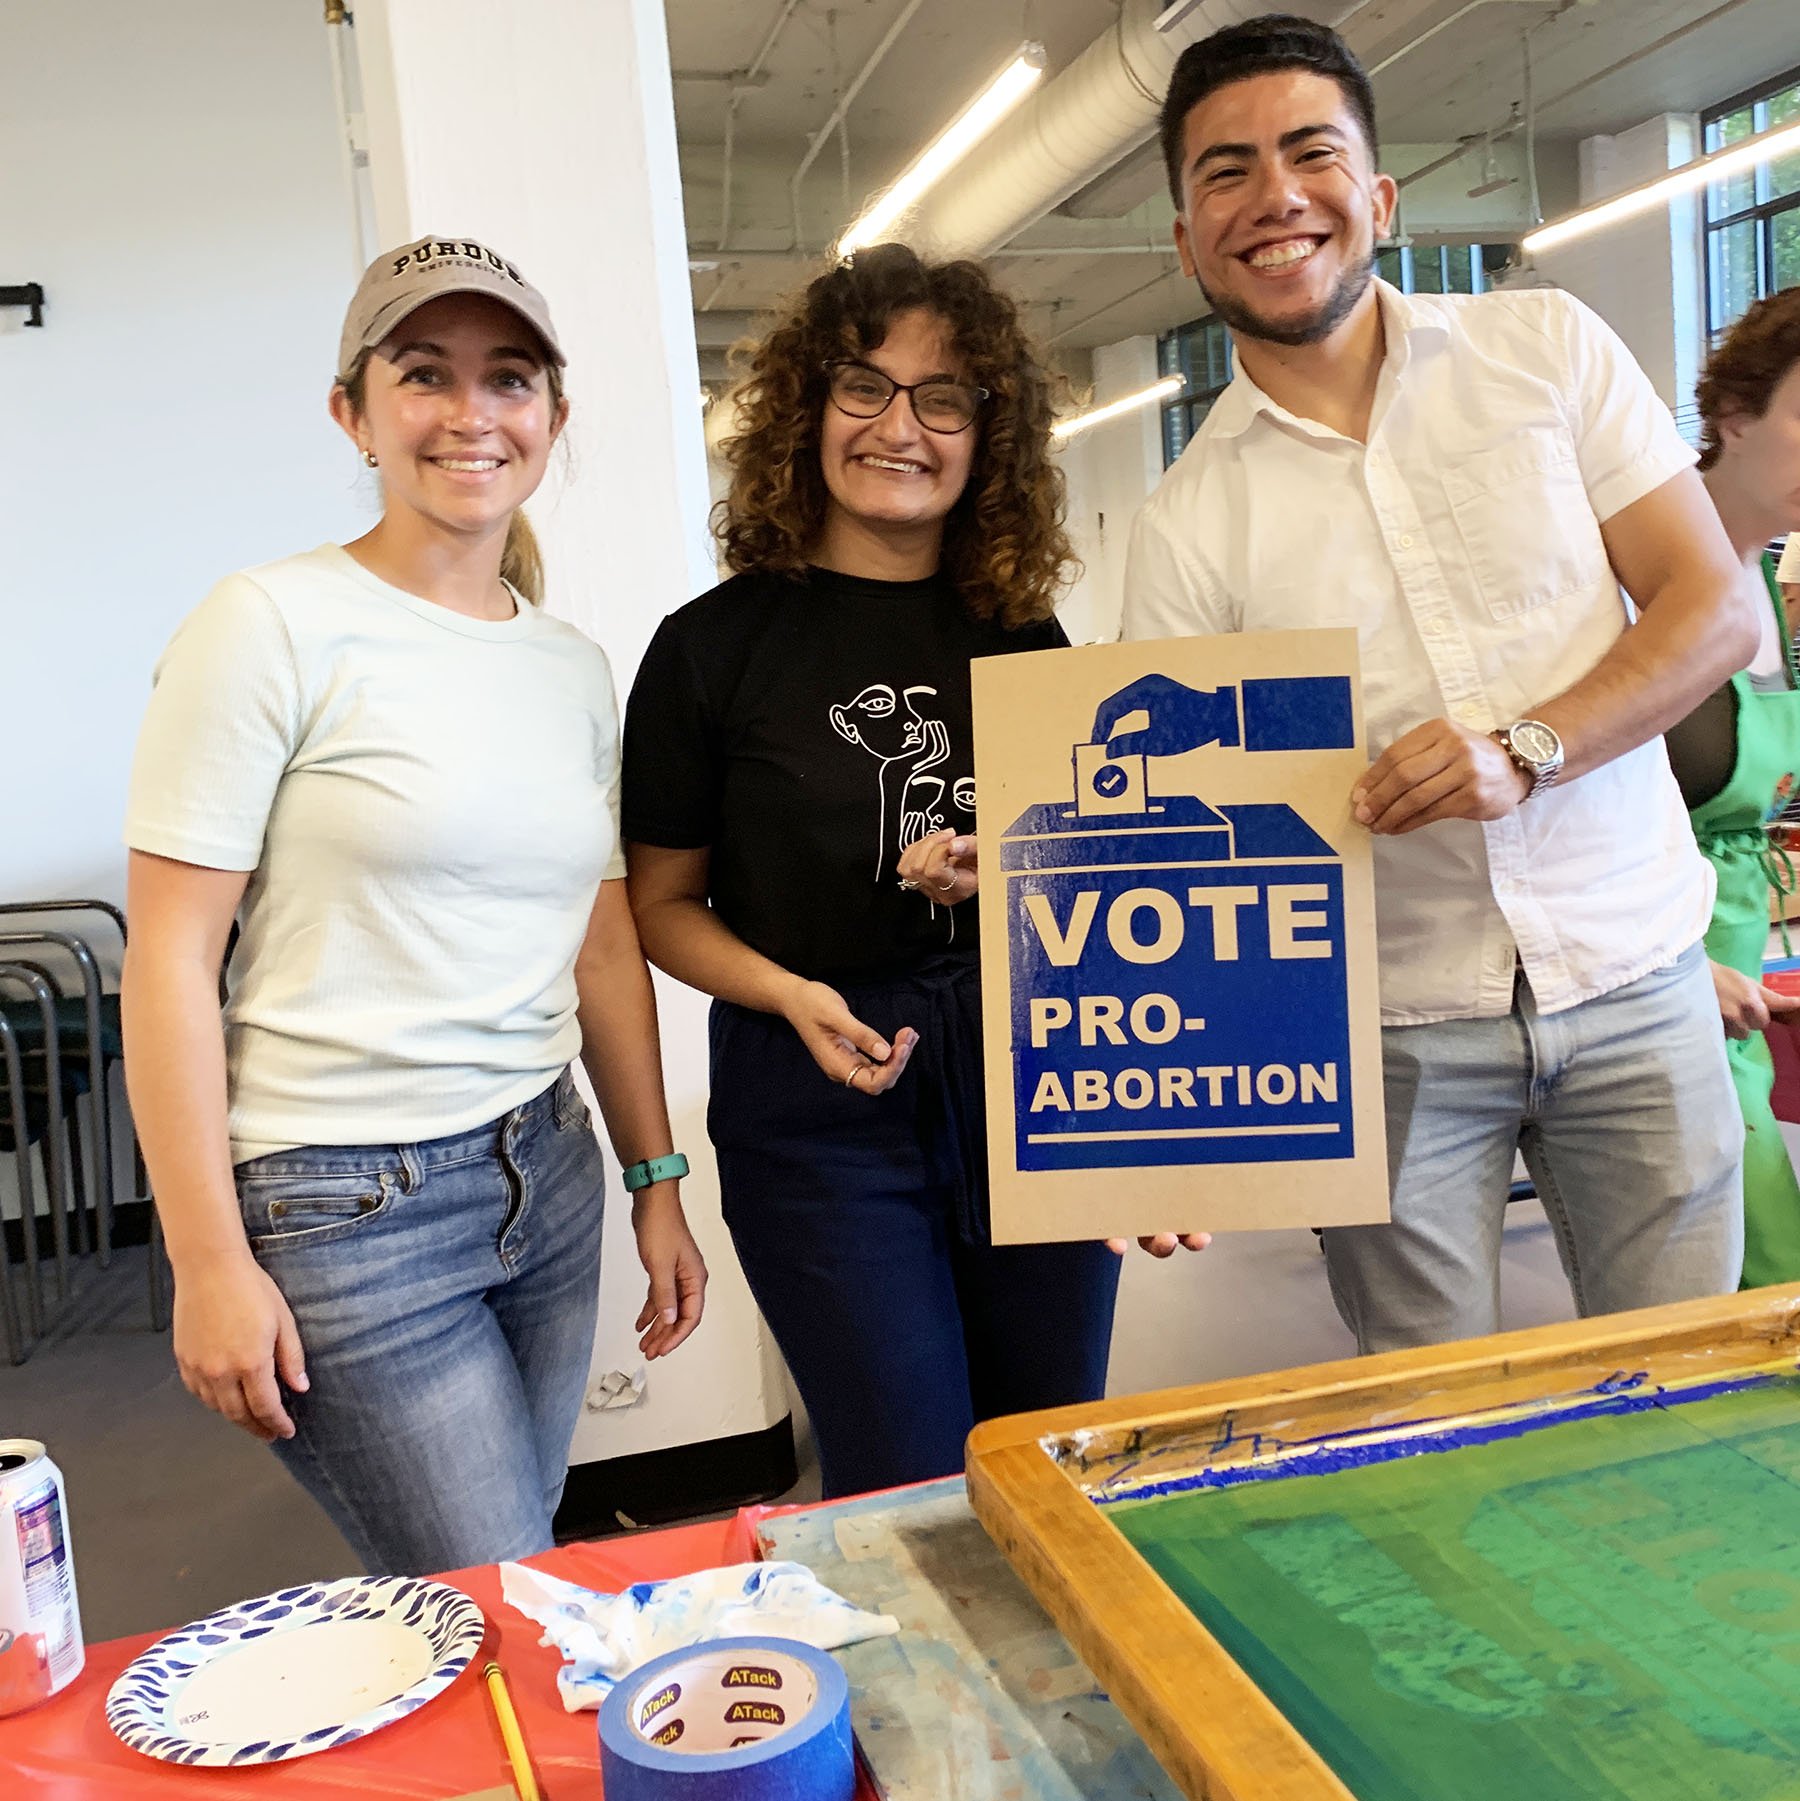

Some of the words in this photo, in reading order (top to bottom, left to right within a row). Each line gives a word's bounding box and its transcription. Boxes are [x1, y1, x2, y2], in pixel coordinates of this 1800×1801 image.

[393, 242, 526, 288] PURDUE
[418, 259, 505, 281] UNIVERSITY
[1024, 883, 1333, 967] VOTE
[1030, 993, 1206, 1048] PRO-
[1029, 1062, 1338, 1113] ABORTION
[729, 1669, 777, 1687] ATack
[641, 1689, 675, 1723] ATack
[732, 1705, 780, 1722] ATack
